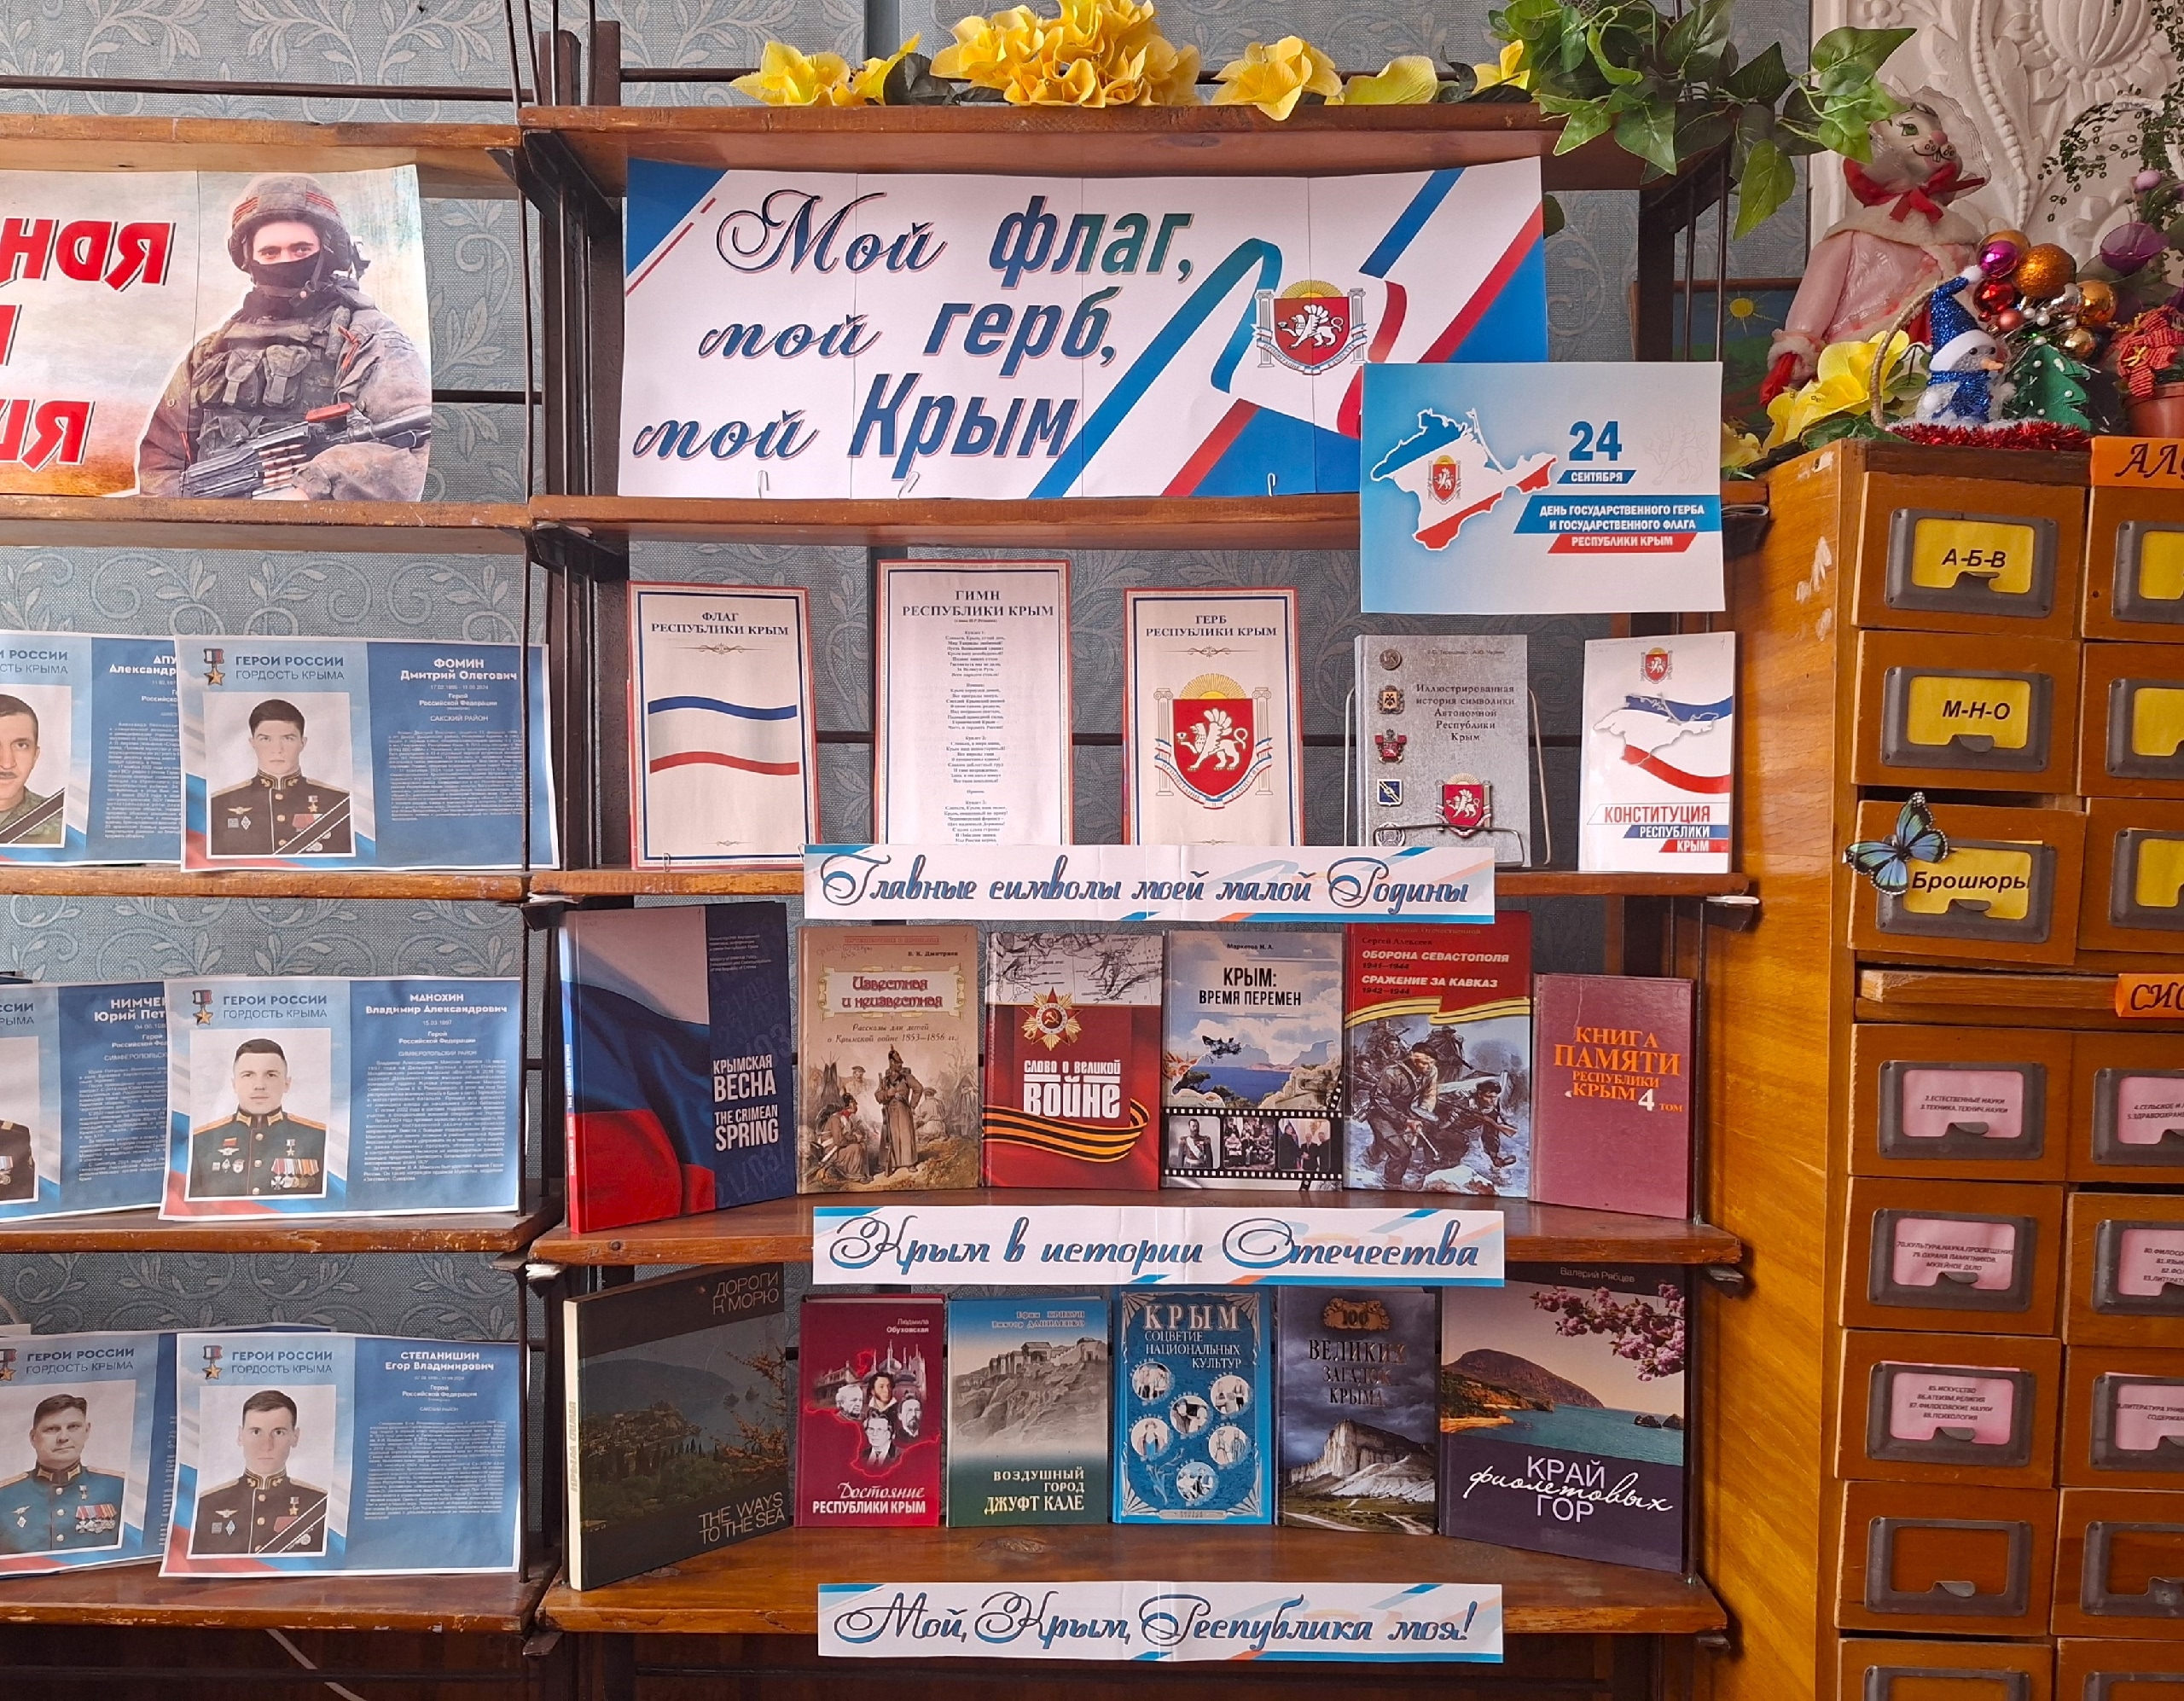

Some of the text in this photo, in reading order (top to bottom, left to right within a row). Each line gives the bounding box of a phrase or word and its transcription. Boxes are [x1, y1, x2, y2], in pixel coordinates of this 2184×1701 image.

[716, 189, 1196, 288] Мой флаг,
[697, 286, 1123, 378] мой герб,
[632, 373, 1081, 480] мой Крым
[1569, 421, 1623, 462] 24
[1571, 471, 1623, 482] СЕНТЯБРЯ
[1540, 504, 1705, 516] ДЕНЬ ГОСУДАРСТВЕННОГО ГЕРБА
[1549, 520, 1696, 531] И ГОСУДАРСТВЕННОГО ФЛАГА
[1571, 536, 1673, 547] РЕСПУБЛИКИ КРЫМ
[1942, 548, 2007, 569] А-Б-В
[955, 590, 1001, 601] ГИМН
[701, 612, 740, 622] ФЛАГ
[902, 606, 1054, 617] РЕСПУБЛИКИ КРЫМ
[1195, 615, 1227, 624] ГЕРБ
[651, 623, 789, 636] РЕСПУБЛИКИ КРЫМ
[1146, 627, 1277, 637] РЕСПУБЛИКИ КРЫМ
[9, 650, 68, 660] РОССИИ
[235, 656, 344, 666] ГЕРОИ РОССИИ
[26, 665, 69, 674] КРЫМА
[433, 658, 485, 669] ФОМИН
[235, 670, 345, 681] ГОРДОСТЬ КРЫМА
[401, 670, 517, 681] Дмитрий Олегович
[1416, 684, 1514, 694] Иллюстрированная
[1416, 697, 1515, 706] история символики
[1434, 708, 1496, 718] Автономной
[1943, 700, 2011, 721] М-Н-О
[1436, 720, 1496, 730] Республики
[1451, 732, 1480, 742] Крым
[1605, 804, 1711, 824] КОНСТИТУЦИЯ
[1640, 825, 1710, 838] РЕСПУБЛИКИ
[1676, 839, 1709, 852] КРЫМ
[821, 853, 1468, 914] Главные символы моей малой Родины
[1362, 950, 1509, 963] ОБОРОНА СЕВАСТОПОЛЯ
[1223, 967, 1277, 987] КРЫМ:
[1362, 975, 1498, 988] СРАЖЕНИЕ ЗА КАВКАЗ
[852, 976, 928, 992] Известная
[223, 995, 328, 1007] ГЕРОИ РОССИИ
[410, 994, 464, 1002] МАНОХИН
[842, 996, 944, 1009] и неизвестная
[1199, 990, 1301, 1006] ВРЕМЯ ПЕРЕМЕН
[94, 1009, 136, 1023] Юрий
[223, 1007, 328, 1020] ГОРДОСТЬ КРЫМА
[366, 1005, 508, 1014] Владимир Александрович
[835, 1034, 874, 1043] Крымской
[1576, 1026, 1658, 1048] КНИГА
[713, 1054, 773, 1075] КРЫМСКАЯ
[1554, 1044, 1681, 1077] ПАМЯТИ
[713, 1069, 776, 1103] ВЕСНА
[1572, 1071, 1659, 1089] РЕСПУБЛИКИ
[1573, 1083, 1682, 1112] КРЫМ 4 ТОМ
[714, 1105, 778, 1126] THE CRIMEAN
[715, 1118, 779, 1152] SPRING
[829, 1215, 1479, 1275] Крым в истории Отечества
[1560, 1267, 1635, 1283] Валерий Рябцев
[715, 1271, 779, 1299] ДОРОГИ
[729, 1288, 779, 1312] МОРЮ
[897, 1318, 929, 1327] Людмила
[1144, 1303, 1240, 1331] КРЫМ
[1342, 1309, 1369, 1326] 100
[1145, 1331, 1203, 1344] СОЦВЕТИЕ
[27, 1349, 134, 1361] ГЕРОИ РОССИИ
[232, 1350, 333, 1361] ГЕРОИ РОССИИ
[401, 1351, 479, 1361] СТЕПАНИШИН
[1146, 1344, 1240, 1356] НАЦИОНАЛЬНЫХ
[1309, 1339, 1408, 1365] ВЕЛИКИХ
[26, 1361, 133, 1374] ГОРДОСТЬ КРЫМА
[232, 1364, 333, 1375] ГОРДОСТЬ КРЫМА
[385, 1362, 494, 1372] Егор Владимирович
[1192, 1357, 1242, 1369] КУЛЬТУР
[1322, 1365, 1391, 1385] ЗАГАДОК
[1329, 1387, 1386, 1407] КРЫМА
[993, 1466, 1084, 1482] ВОЗДУШНЫЙ
[1527, 1455, 1606, 1489] КРАЙ
[837, 1482, 925, 1499] Достояние
[1044, 1482, 1084, 1494] ГОРОД
[1463, 1466, 1673, 1512] фиолетовых
[699, 1492, 783, 1530] THE WAYS
[813, 1501, 926, 1513] РЕСПУБЛИКИ КРЫМ
[985, 1495, 1084, 1515] ДЖУФТ КАЛЕ
[1536, 1495, 1594, 1523] ГОР
[700, 1507, 785, 1545] TO THE SEA
[834, 1590, 1478, 1652] Мой, Крым, Республика моя!
